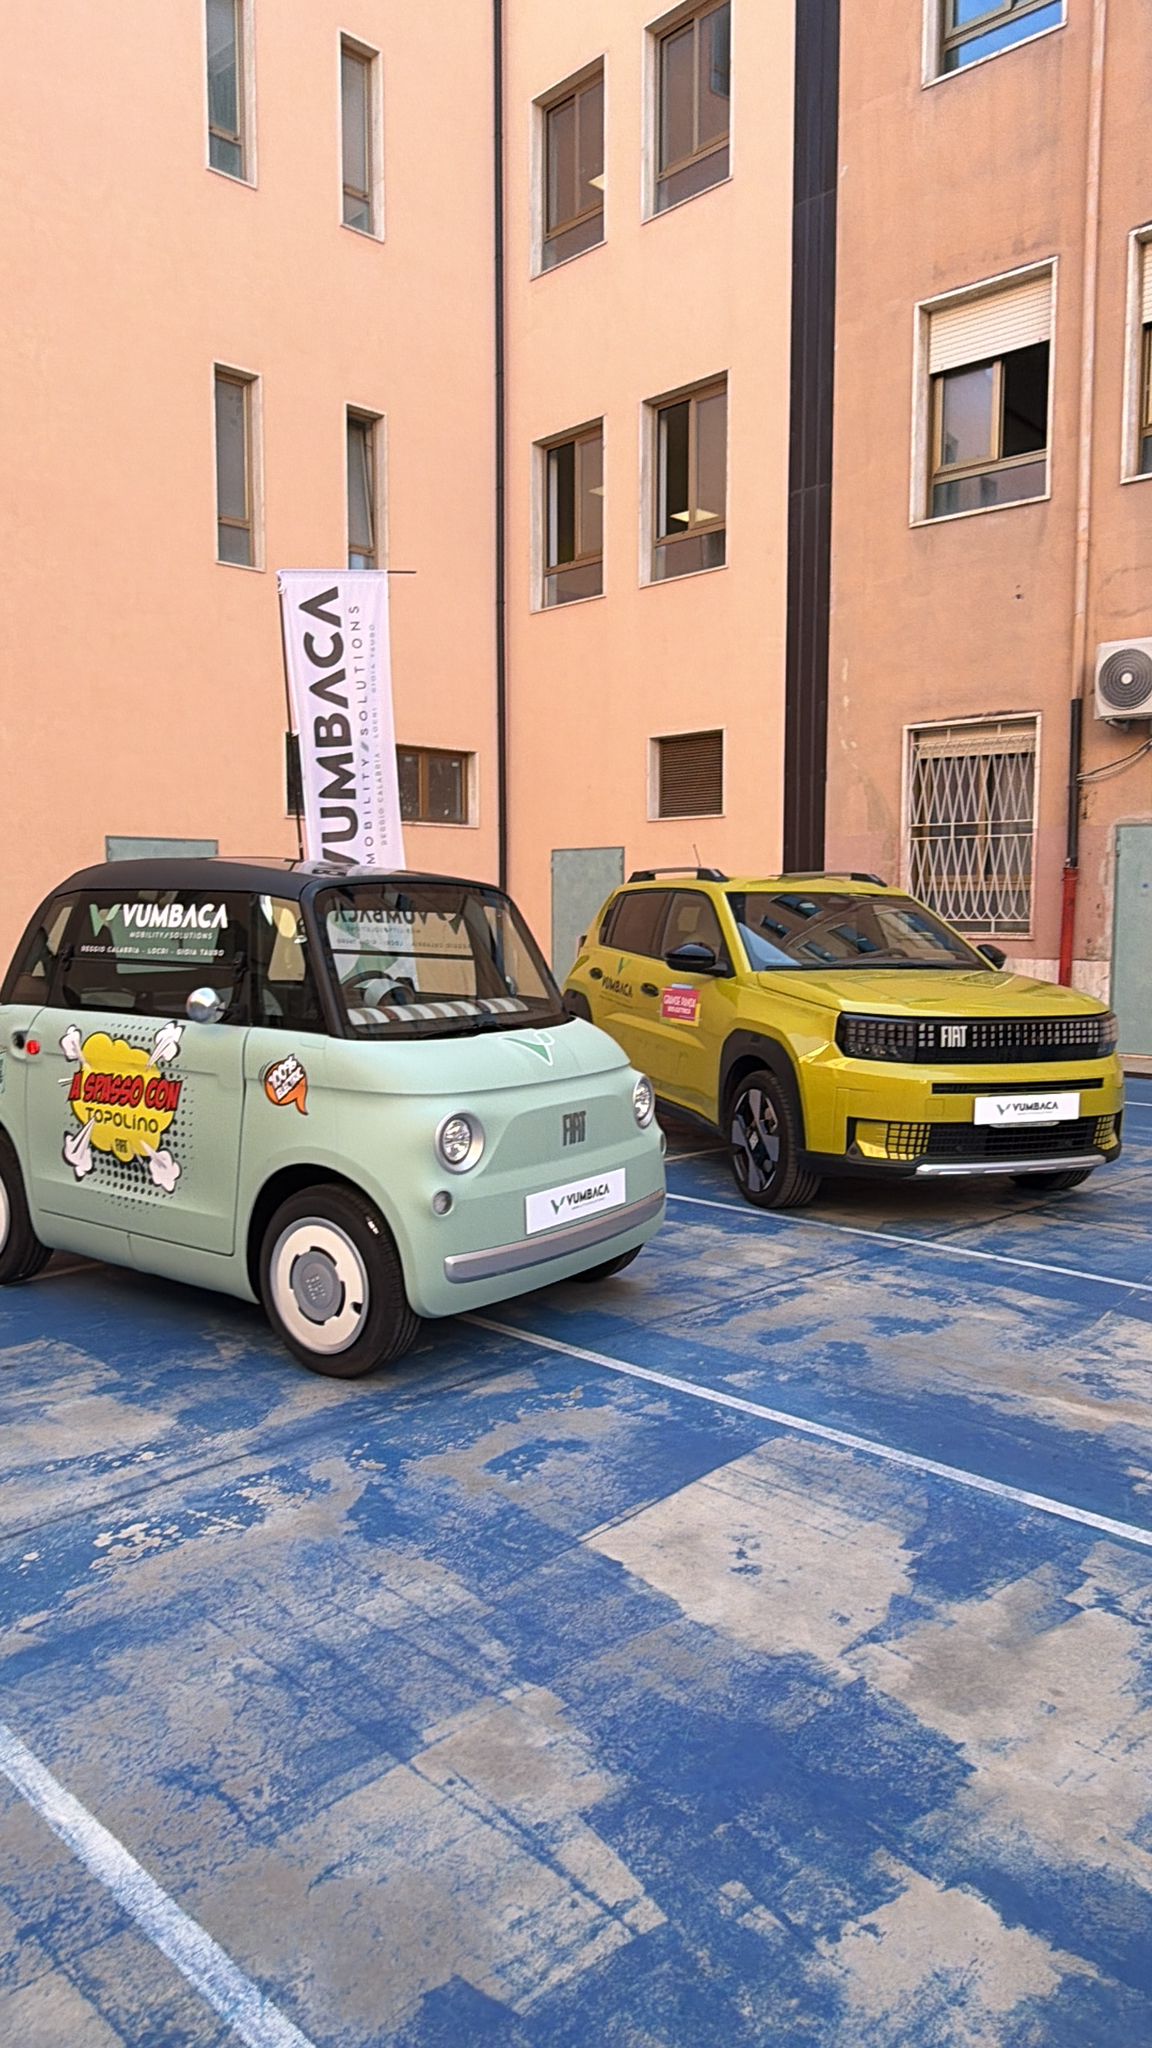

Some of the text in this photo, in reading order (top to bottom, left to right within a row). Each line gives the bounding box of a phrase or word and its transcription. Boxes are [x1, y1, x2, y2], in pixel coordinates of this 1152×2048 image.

[122, 903, 228, 929] VUMBACA
[940, 1025, 968, 1048] FIAT
[268, 1055, 298, 1090] 100%
[67, 1071, 183, 1112] A SPASSO CON
[1012, 1101, 1059, 1112] VUMBACA
[562, 1110, 587, 1147] FIAT
[566, 1183, 610, 1206] VUMBACA
